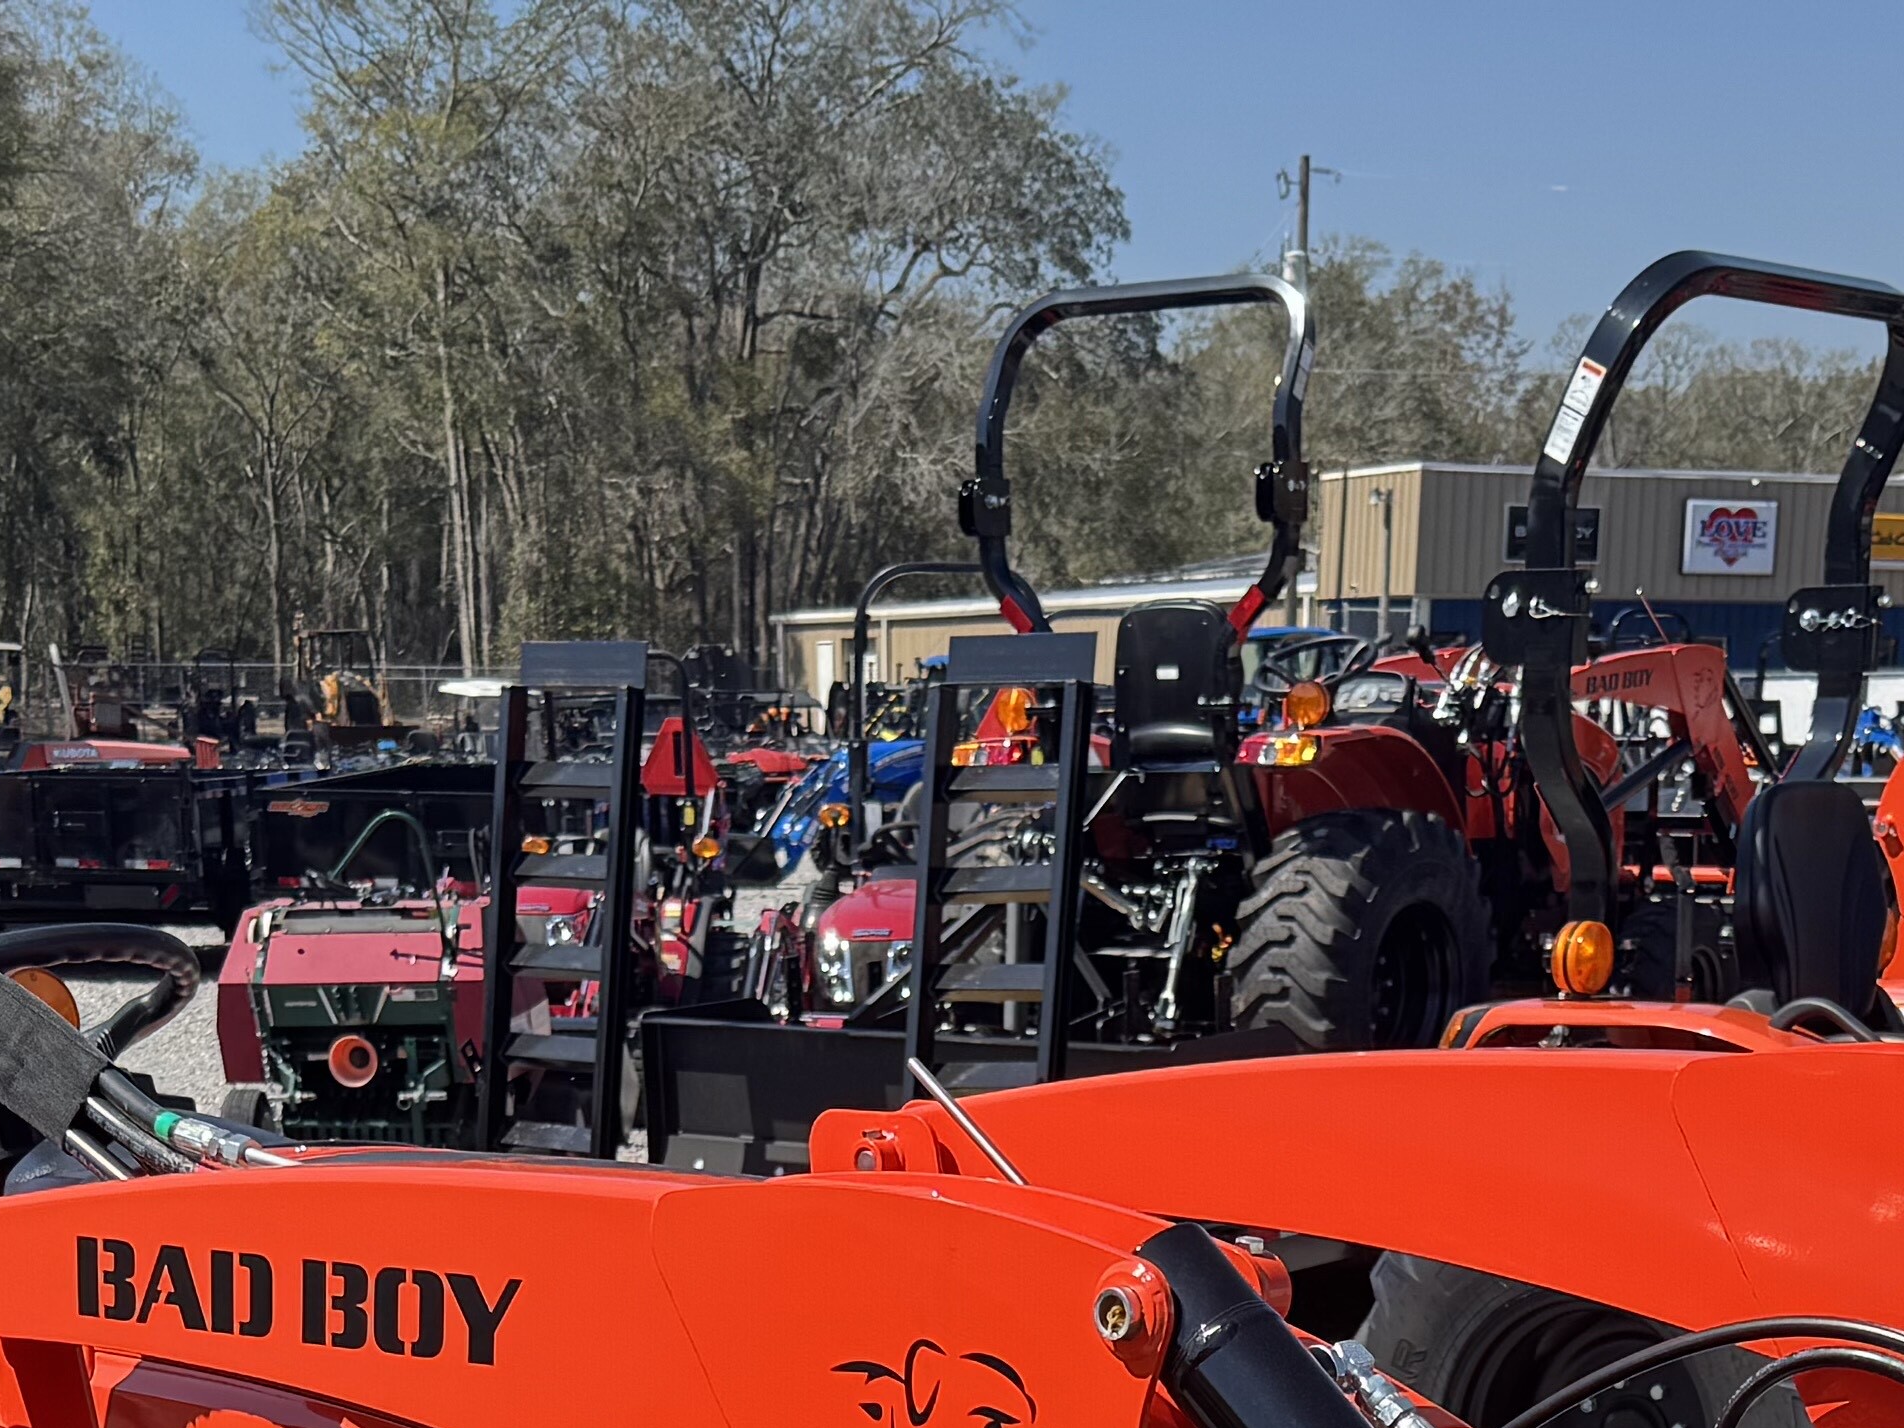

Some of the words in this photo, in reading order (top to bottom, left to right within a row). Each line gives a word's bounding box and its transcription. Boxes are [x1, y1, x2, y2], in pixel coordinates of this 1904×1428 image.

[1699, 519, 1768, 538] LOVE
[1586, 671, 1619, 695] BAD
[1623, 668, 1654, 690] BOY
[76, 1236, 273, 1338] BAD
[301, 1258, 522, 1366] BOY
